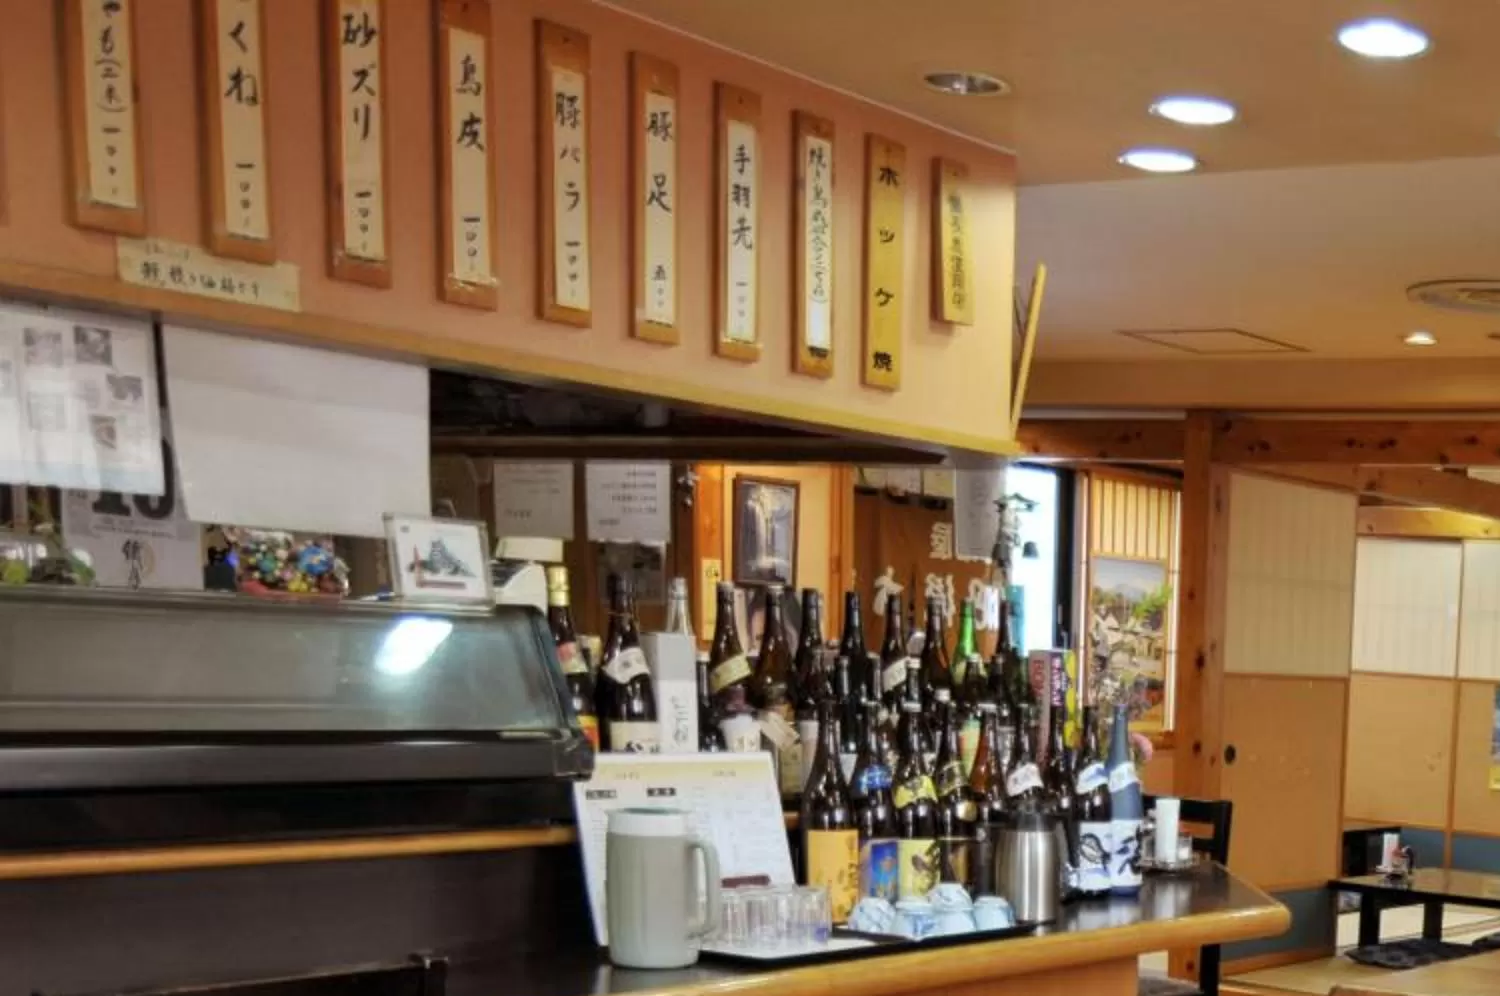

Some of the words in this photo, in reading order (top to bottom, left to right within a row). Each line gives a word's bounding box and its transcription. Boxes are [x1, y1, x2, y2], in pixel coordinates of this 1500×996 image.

[225, 0, 259, 106] くね
[342, 12, 377, 140] 砂ズリ
[456, 53, 484, 151] 鳥皮
[646, 111, 673, 214] 豚足
[731, 144, 753, 251] 手羽先
